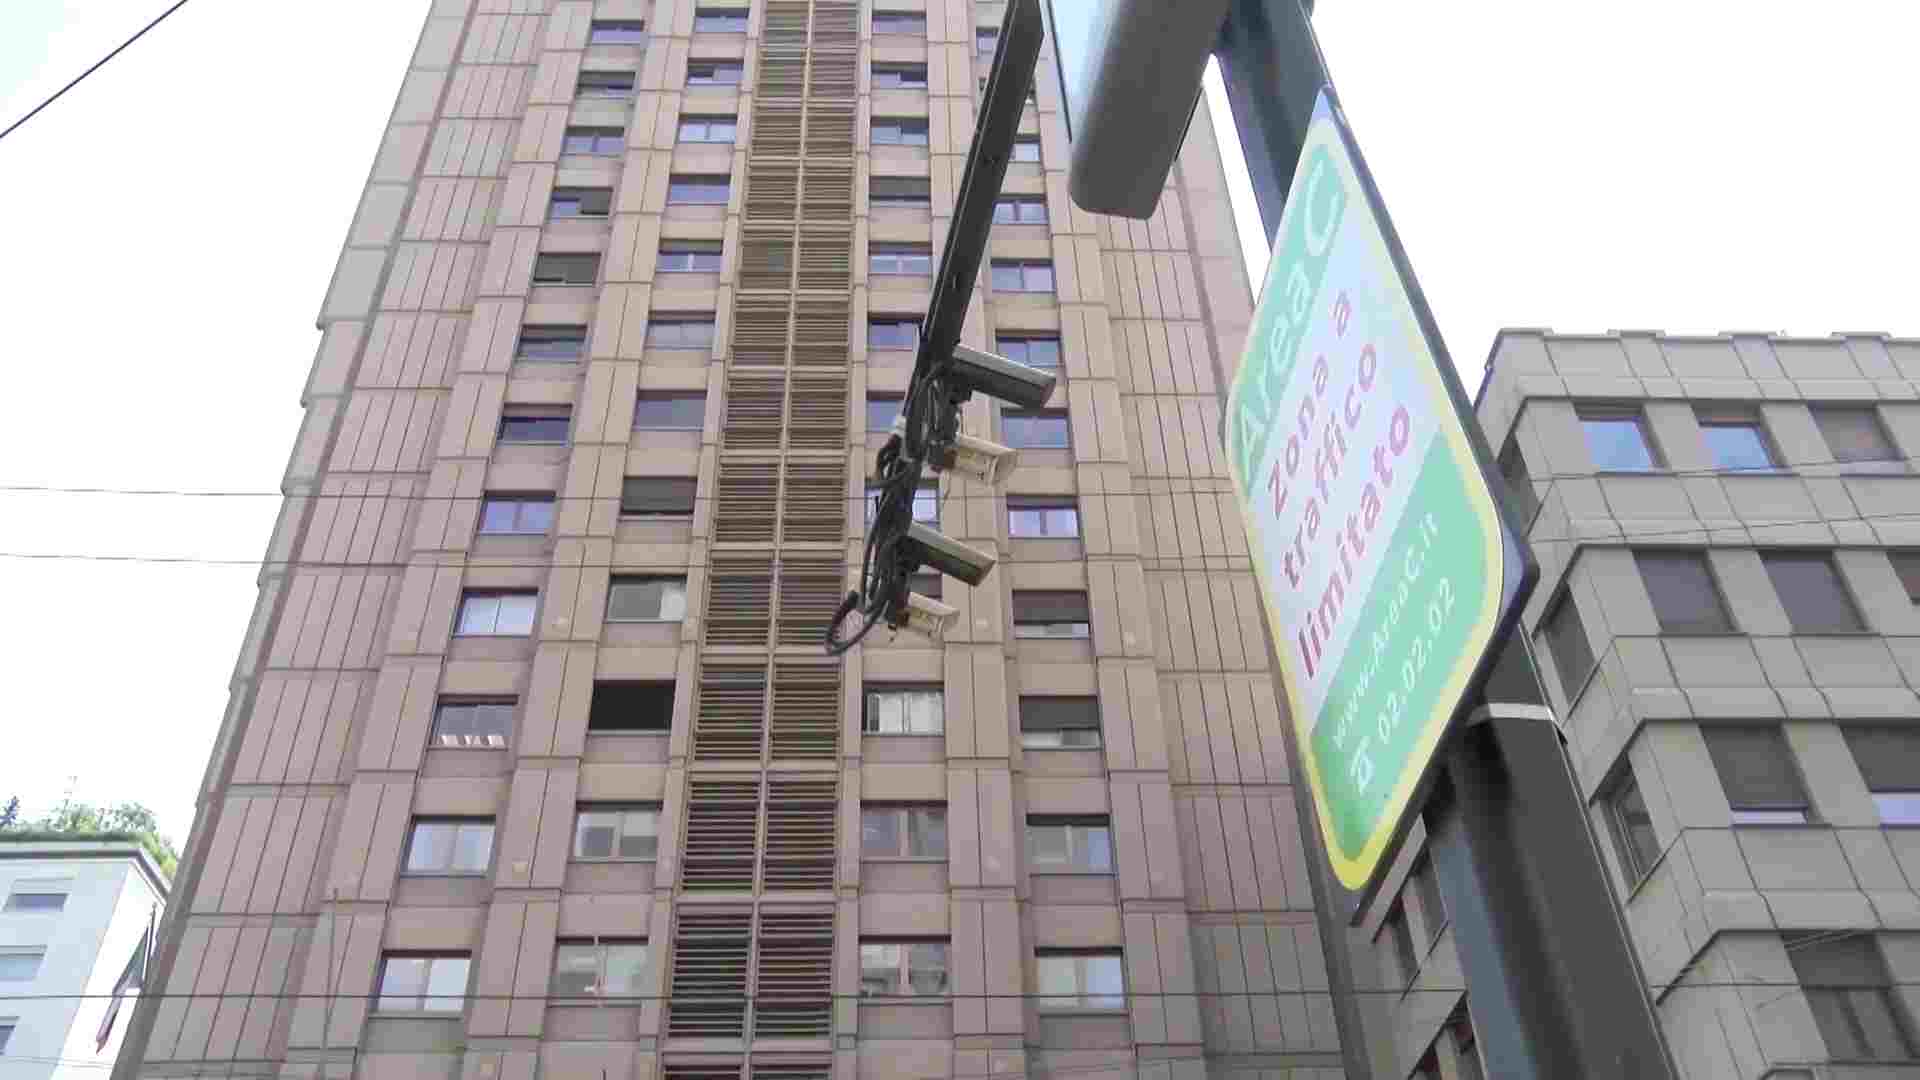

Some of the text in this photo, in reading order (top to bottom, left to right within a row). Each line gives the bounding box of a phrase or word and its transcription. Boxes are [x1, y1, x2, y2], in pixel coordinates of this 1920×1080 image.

[1331, 291, 1351, 338] a
[1281, 343, 1376, 589] traffico
[1299, 404, 1410, 679] limitato
[1376, 577, 1456, 744] 02.02.02
